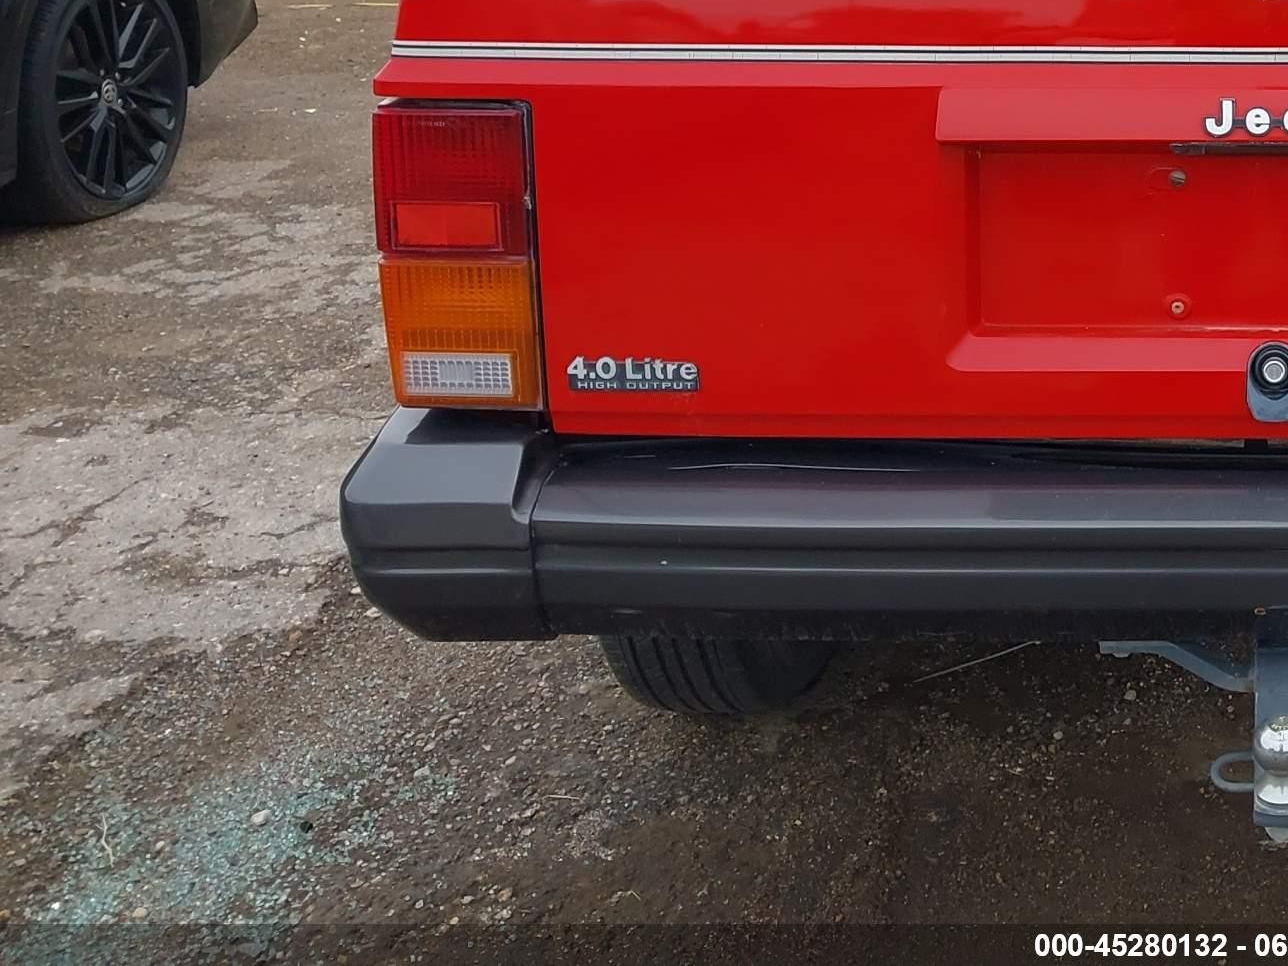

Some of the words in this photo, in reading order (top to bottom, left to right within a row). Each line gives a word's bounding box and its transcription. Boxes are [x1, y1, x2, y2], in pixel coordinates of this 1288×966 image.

[566, 356, 618, 381] 4.0
[625, 356, 698, 381] Litre
[577, 381, 618, 390] HIGH
[626, 381, 694, 390] OUTPUT
